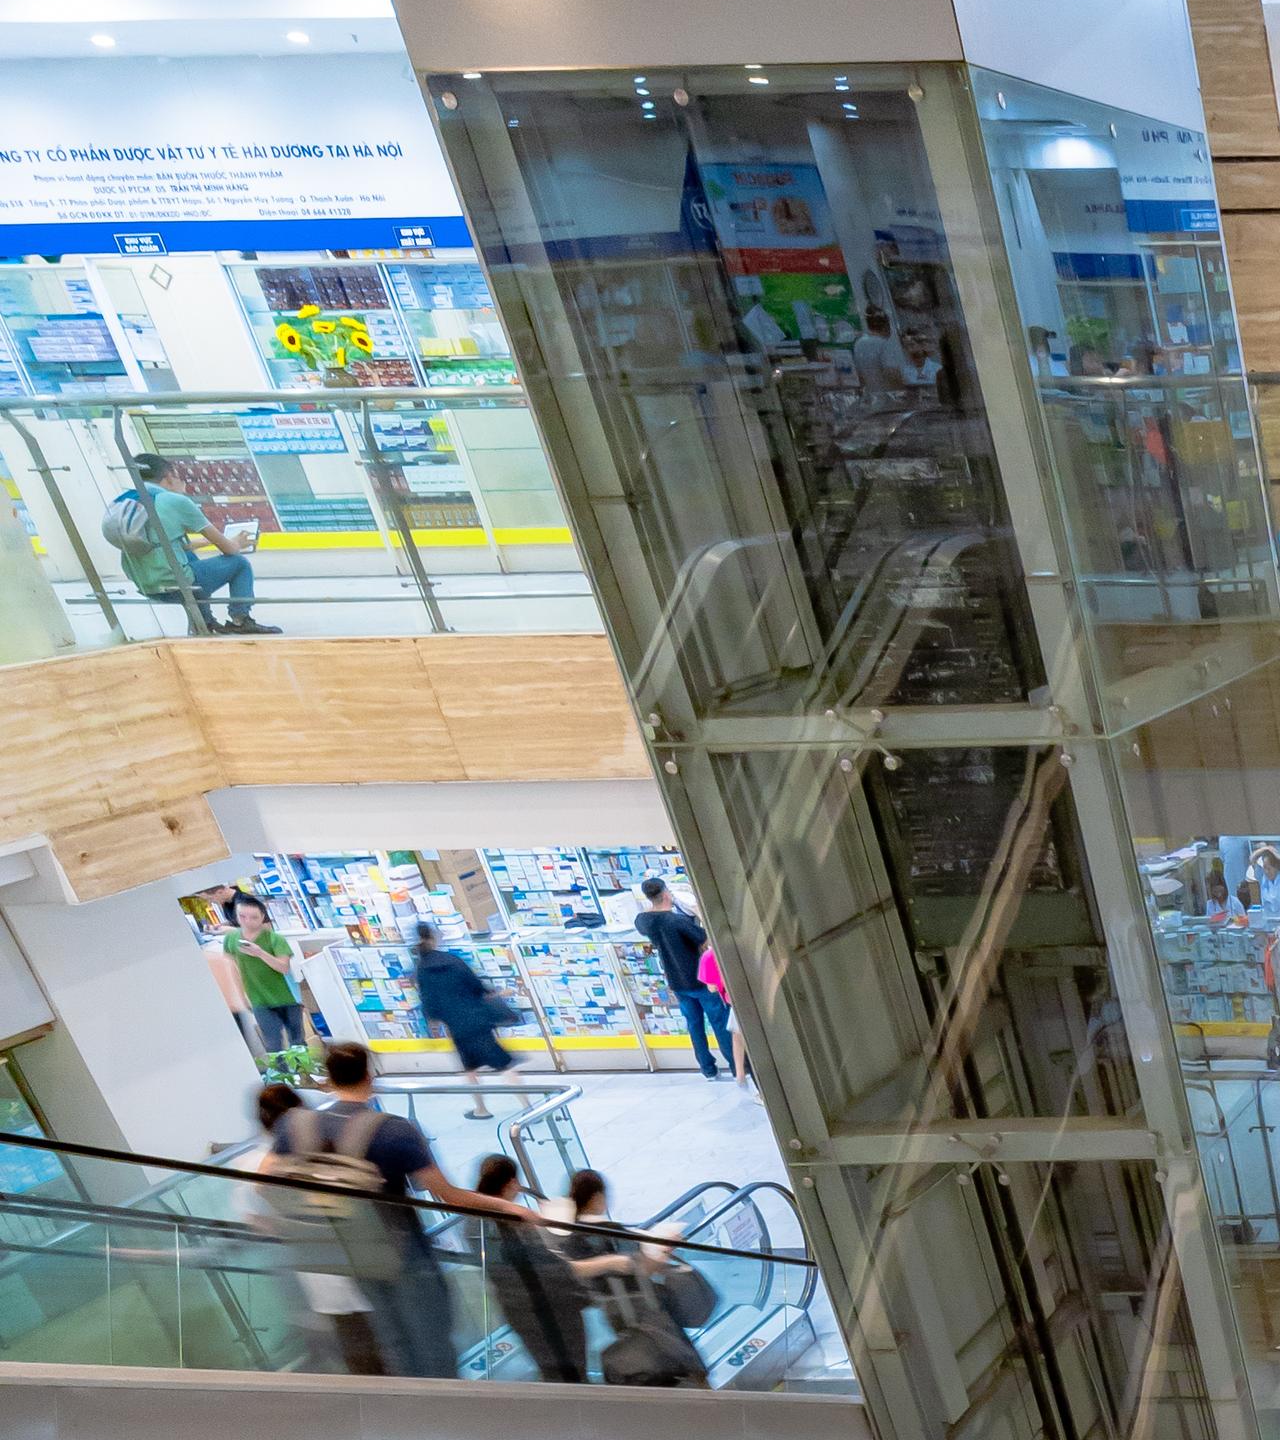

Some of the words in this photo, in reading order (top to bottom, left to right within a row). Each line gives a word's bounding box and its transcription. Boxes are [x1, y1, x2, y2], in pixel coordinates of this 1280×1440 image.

[24, 150, 40, 163] TY
[113, 146, 154, 164] DƯỢC
[187, 145, 204, 160] TƯ
[208, 146, 216, 159] Y
[271, 143, 323, 158] DƯƠNG
[326, 144, 349, 160] TẠI
[353, 141, 373, 158] HÀ
[376, 141, 403, 160] NỘI
